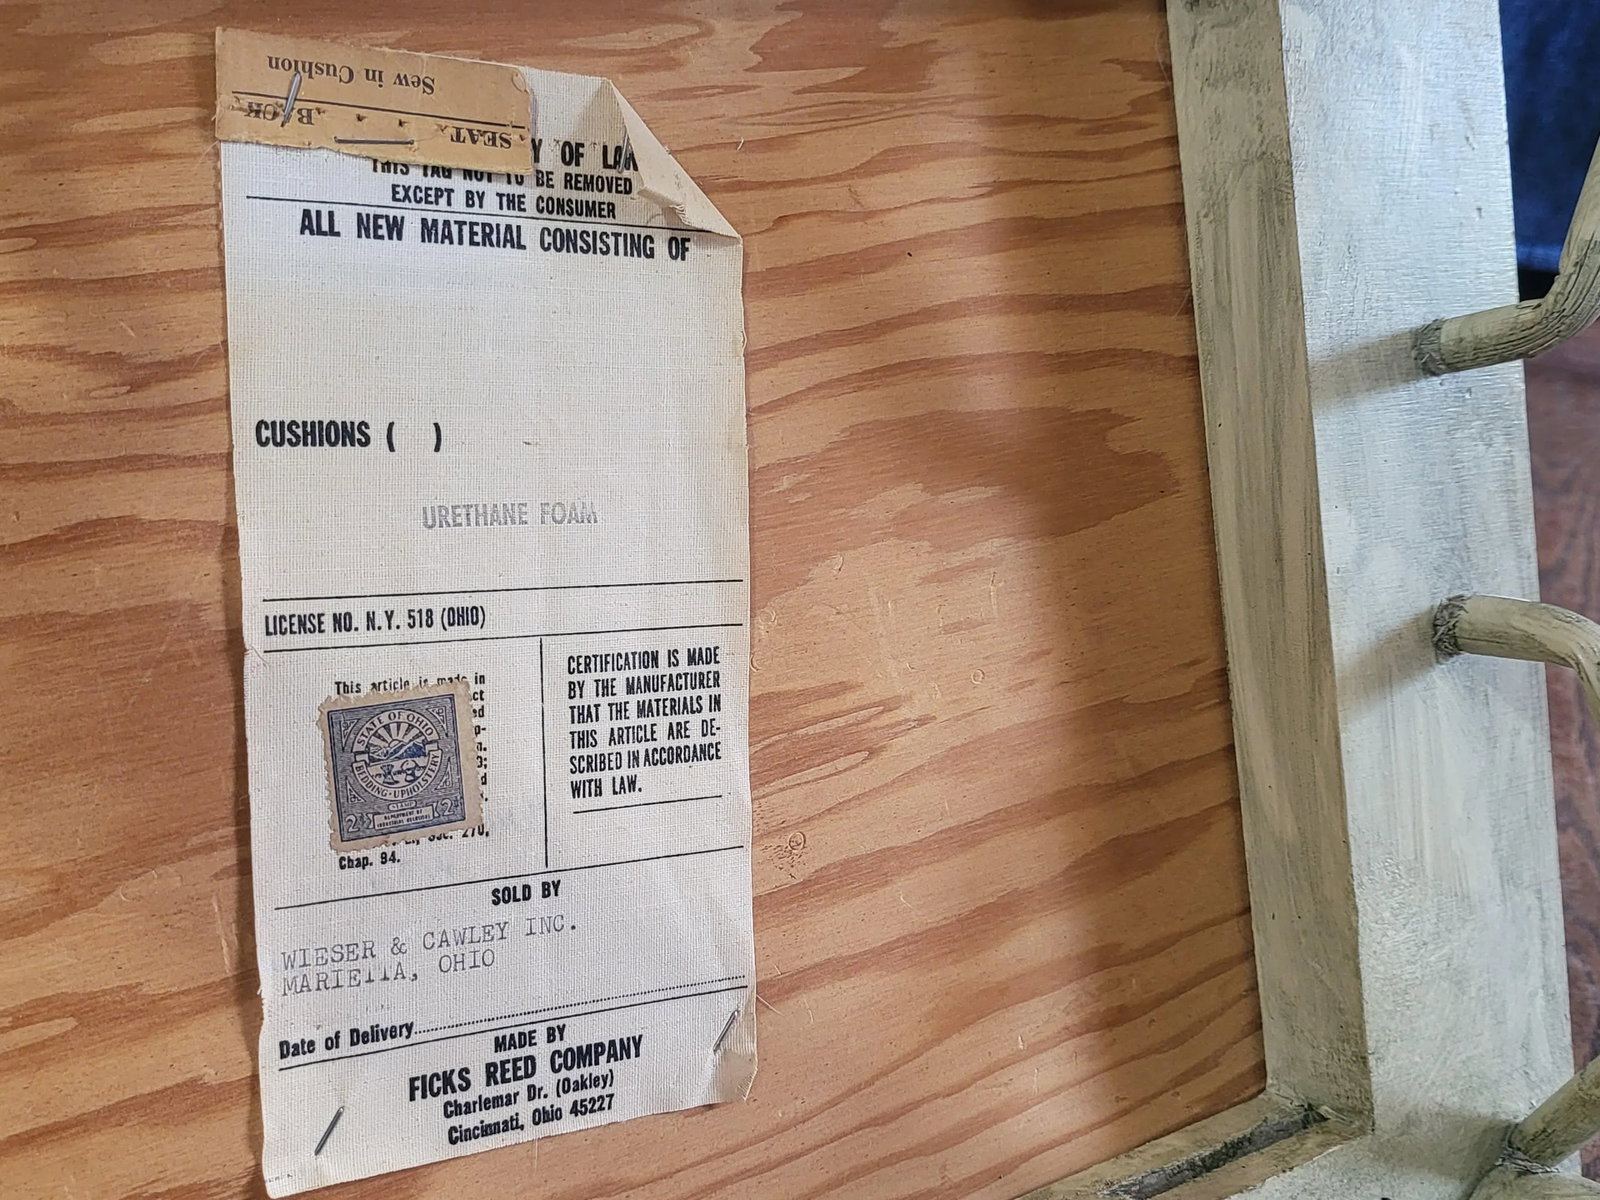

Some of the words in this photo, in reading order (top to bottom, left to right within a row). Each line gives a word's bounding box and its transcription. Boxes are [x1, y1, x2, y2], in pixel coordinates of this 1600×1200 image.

[267, 55, 354, 84] Cushion
[364, 67, 384, 88] in
[393, 73, 434, 95] Sew
[450, 126, 512, 149] SEAT
[561, 141, 584, 167] OF
[536, 170, 554, 188] BE
[564, 172, 632, 195] REMOVED
[391, 184, 454, 206] EXCEPT
[465, 190, 485, 208] BY
[496, 192, 526, 212] THE
[536, 195, 616, 219] CONSUMER
[299, 208, 340, 237] ALL
[356, 213, 403, 242] NEW
[420, 218, 527, 251] MATERIAL
[539, 228, 655, 260] CONSISTING
[668, 237, 691, 261] OF
[255, 420, 371, 448] CUSHIONS
[422, 502, 528, 529] URETHANE
[540, 500, 598, 525] FOAM
[264, 613, 326, 636] LICENSE
[332, 612, 359, 633] NO.
[366, 610, 400, 631] N.Y.
[408, 608, 434, 629] 518
[441, 605, 486, 631] (OHIO)
[567, 650, 659, 675] CERTIFICATION
[668, 649, 679, 667] IS
[687, 646, 720, 666] MADE
[335, 680, 362, 695] This
[474, 672, 485, 685] in
[568, 680, 585, 699] BY
[594, 678, 617, 697] THE
[626, 671, 720, 695] MANUFACTURER
[569, 703, 600, 724] THAT
[608, 701, 630, 721] THE
[637, 695, 703, 719] MATERIALS
[709, 694, 721, 712] IN
[357, 716, 383, 746] STATE
[406, 713, 434, 736] OHIO
[569, 730, 597, 749] THIS
[608, 723, 657, 746] ARTICLE
[667, 721, 690, 740] ARE
[701, 718, 720, 737] DE-
[570, 752, 622, 774] SCRIBED
[628, 750, 639, 769] IN
[643, 742, 721, 767] ACCORDANCE
[571, 778, 602, 799] WITH
[612, 774, 642, 795] LAW.
[339, 855, 373, 870] Chap.
[491, 884, 531, 905] SOLD
[541, 880, 561, 898] BY
[281, 941, 376, 970] WIESER
[391, 937, 407, 955] &
[423, 921, 509, 950] CAWLEY
[526, 915, 576, 936] INC.
[439, 949, 495, 973] OHIO
[279, 1039, 316, 1060] Date
[325, 1031, 340, 1050] of
[494, 1030, 537, 1053] MADE
[546, 1024, 566, 1044] BY
[408, 1066, 471, 1101] FICKS
[485, 1055, 536, 1087] REED
[550, 1034, 643, 1074] COMPANY
[443, 1091, 519, 1118] Charlemar
[527, 1084, 548, 1101] Dr.
[556, 1069, 614, 1097] (Oakley)
[448, 1112, 524, 1145] Cincinnati,
[532, 1104, 563, 1126] Ohio
[570, 1093, 614, 1117] 45227
